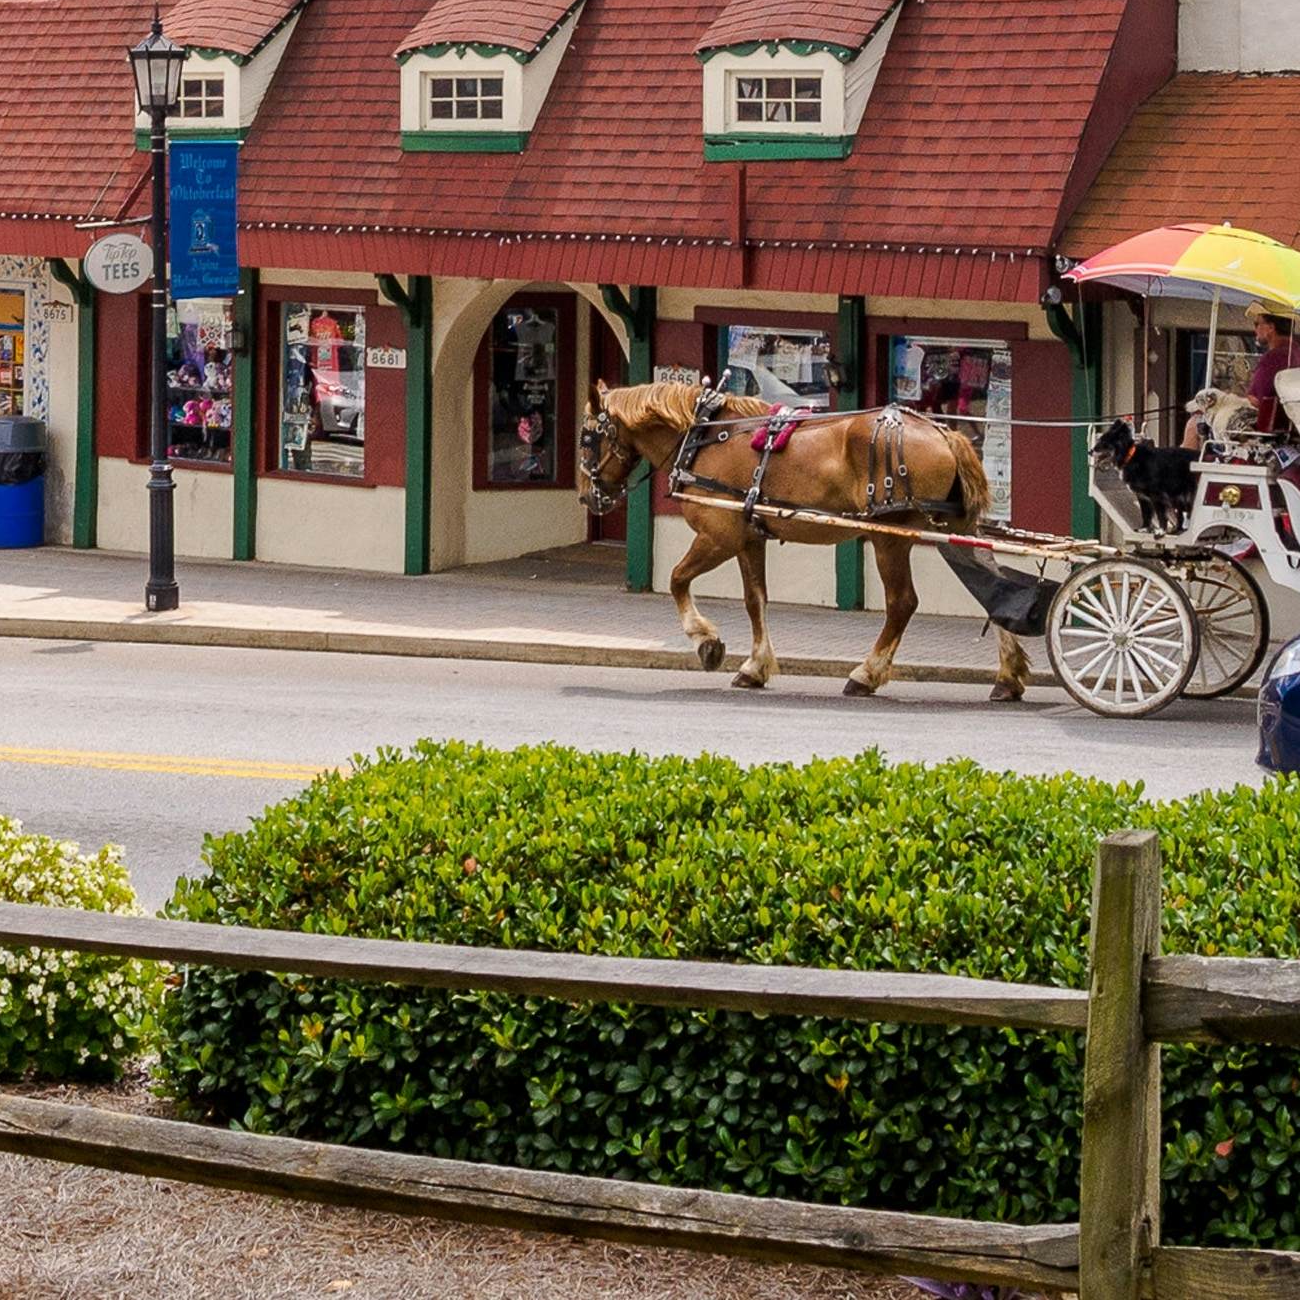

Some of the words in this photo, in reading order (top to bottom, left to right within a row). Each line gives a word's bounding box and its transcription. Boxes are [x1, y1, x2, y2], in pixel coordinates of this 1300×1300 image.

[180, 152, 228, 169] Welcome
[195, 169, 212, 184] To
[170, 184, 235, 200] Oktoberfest
[102, 262, 140, 280] TEES
[44, 308, 66, 320] 8675
[372, 352, 399, 365] 8681
[660, 371, 693, 387] 8685
